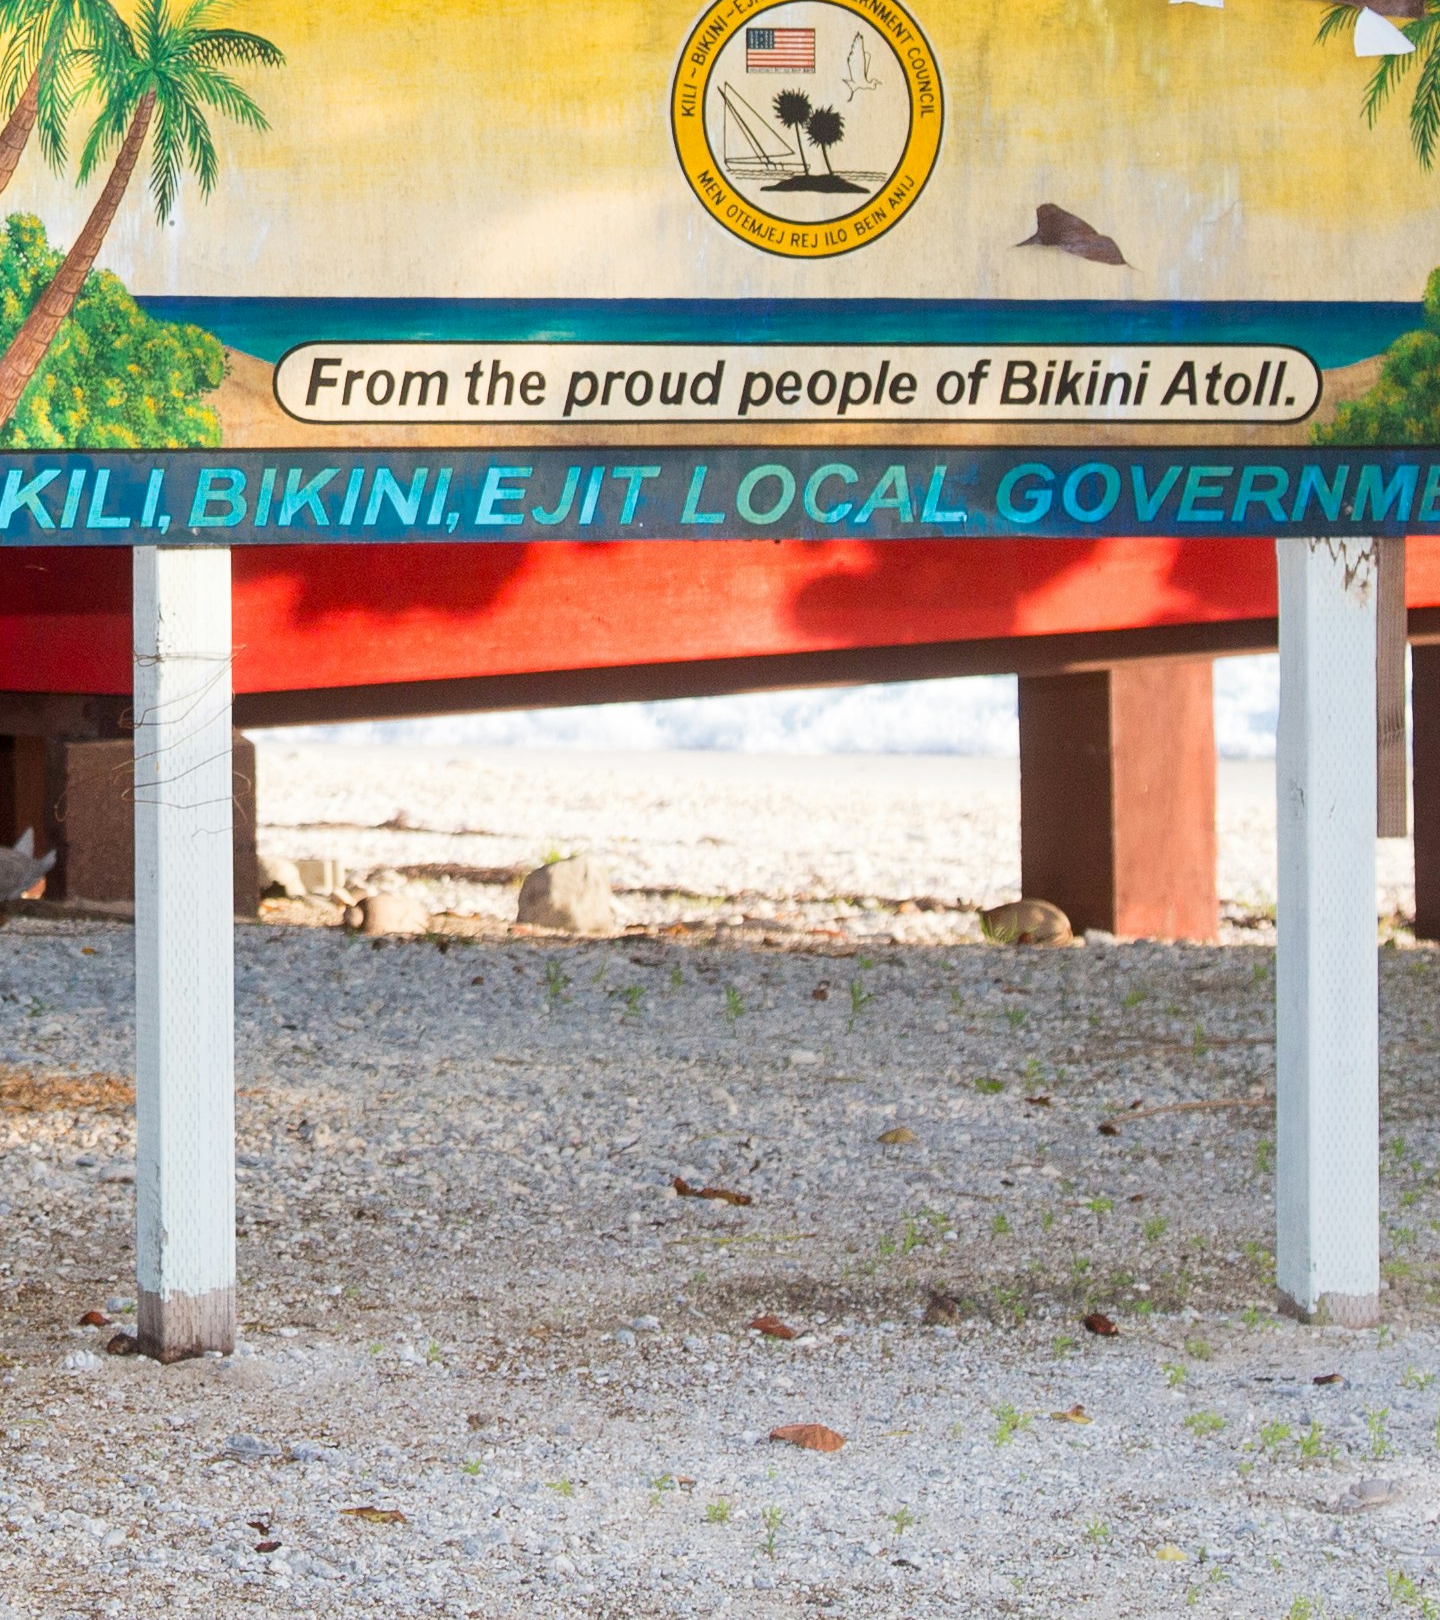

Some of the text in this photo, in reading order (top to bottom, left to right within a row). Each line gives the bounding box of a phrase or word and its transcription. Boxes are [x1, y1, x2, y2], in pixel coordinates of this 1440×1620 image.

[682, 83, 698, 118] KILI
[691, 15, 729, 66] BIKINI
[907, 47, 935, 119] COUNCIL
[697, 169, 916, 249] MEN OTEMJEJ REJ ILO BEIN ANIJ
[305, 357, 1297, 417] From the proud people of Bikini Atoll.
[680, 462, 968, 526] LOCAL
